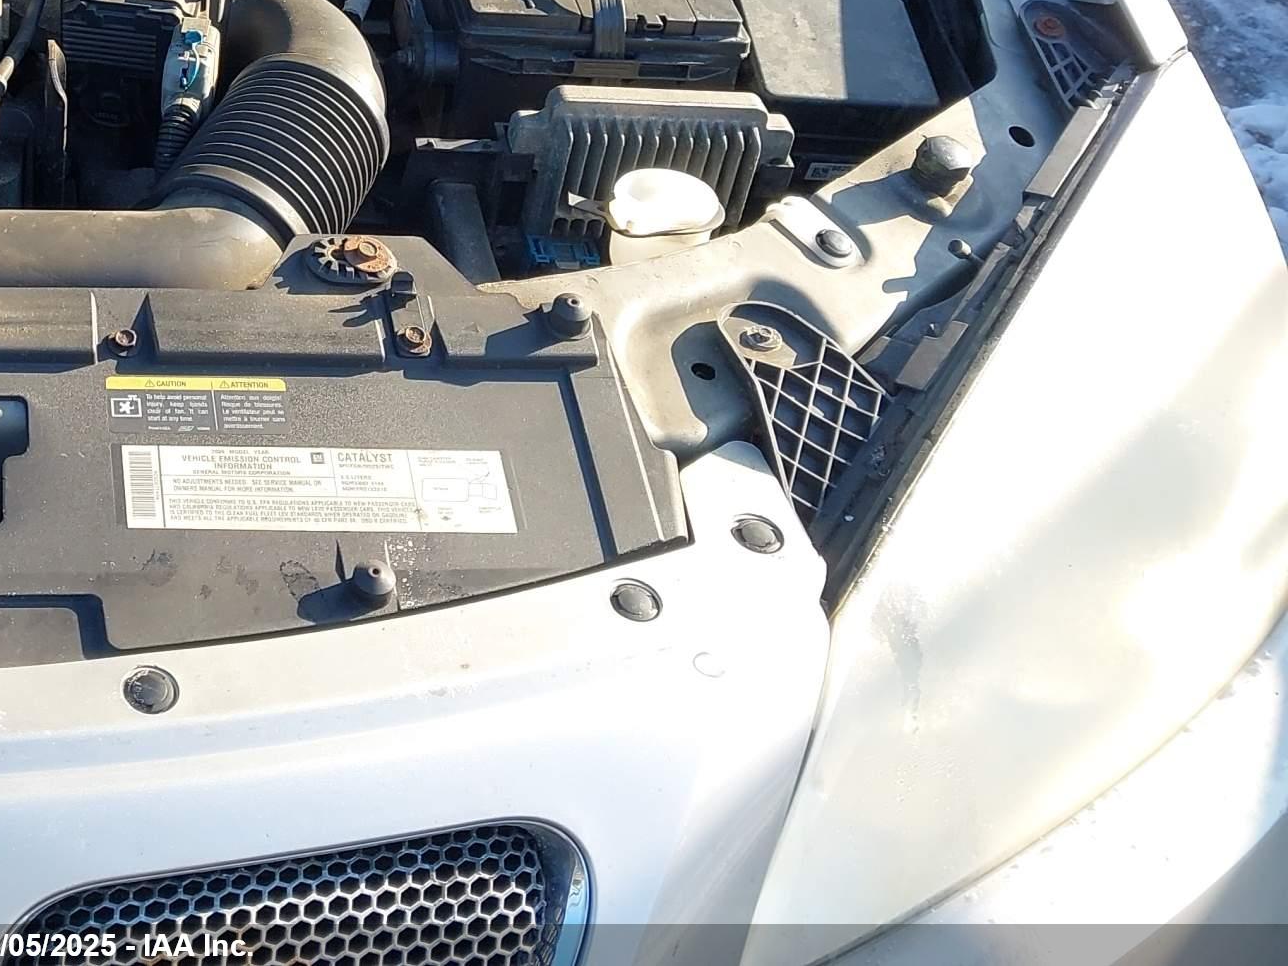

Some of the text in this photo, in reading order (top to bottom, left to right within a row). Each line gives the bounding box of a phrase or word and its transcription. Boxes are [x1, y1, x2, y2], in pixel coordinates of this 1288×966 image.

[182, 454, 302, 464] VEHICLE EMISSION CONTROL
[337, 452, 393, 463] CATALYST
[214, 462, 272, 470] INFORMATION
